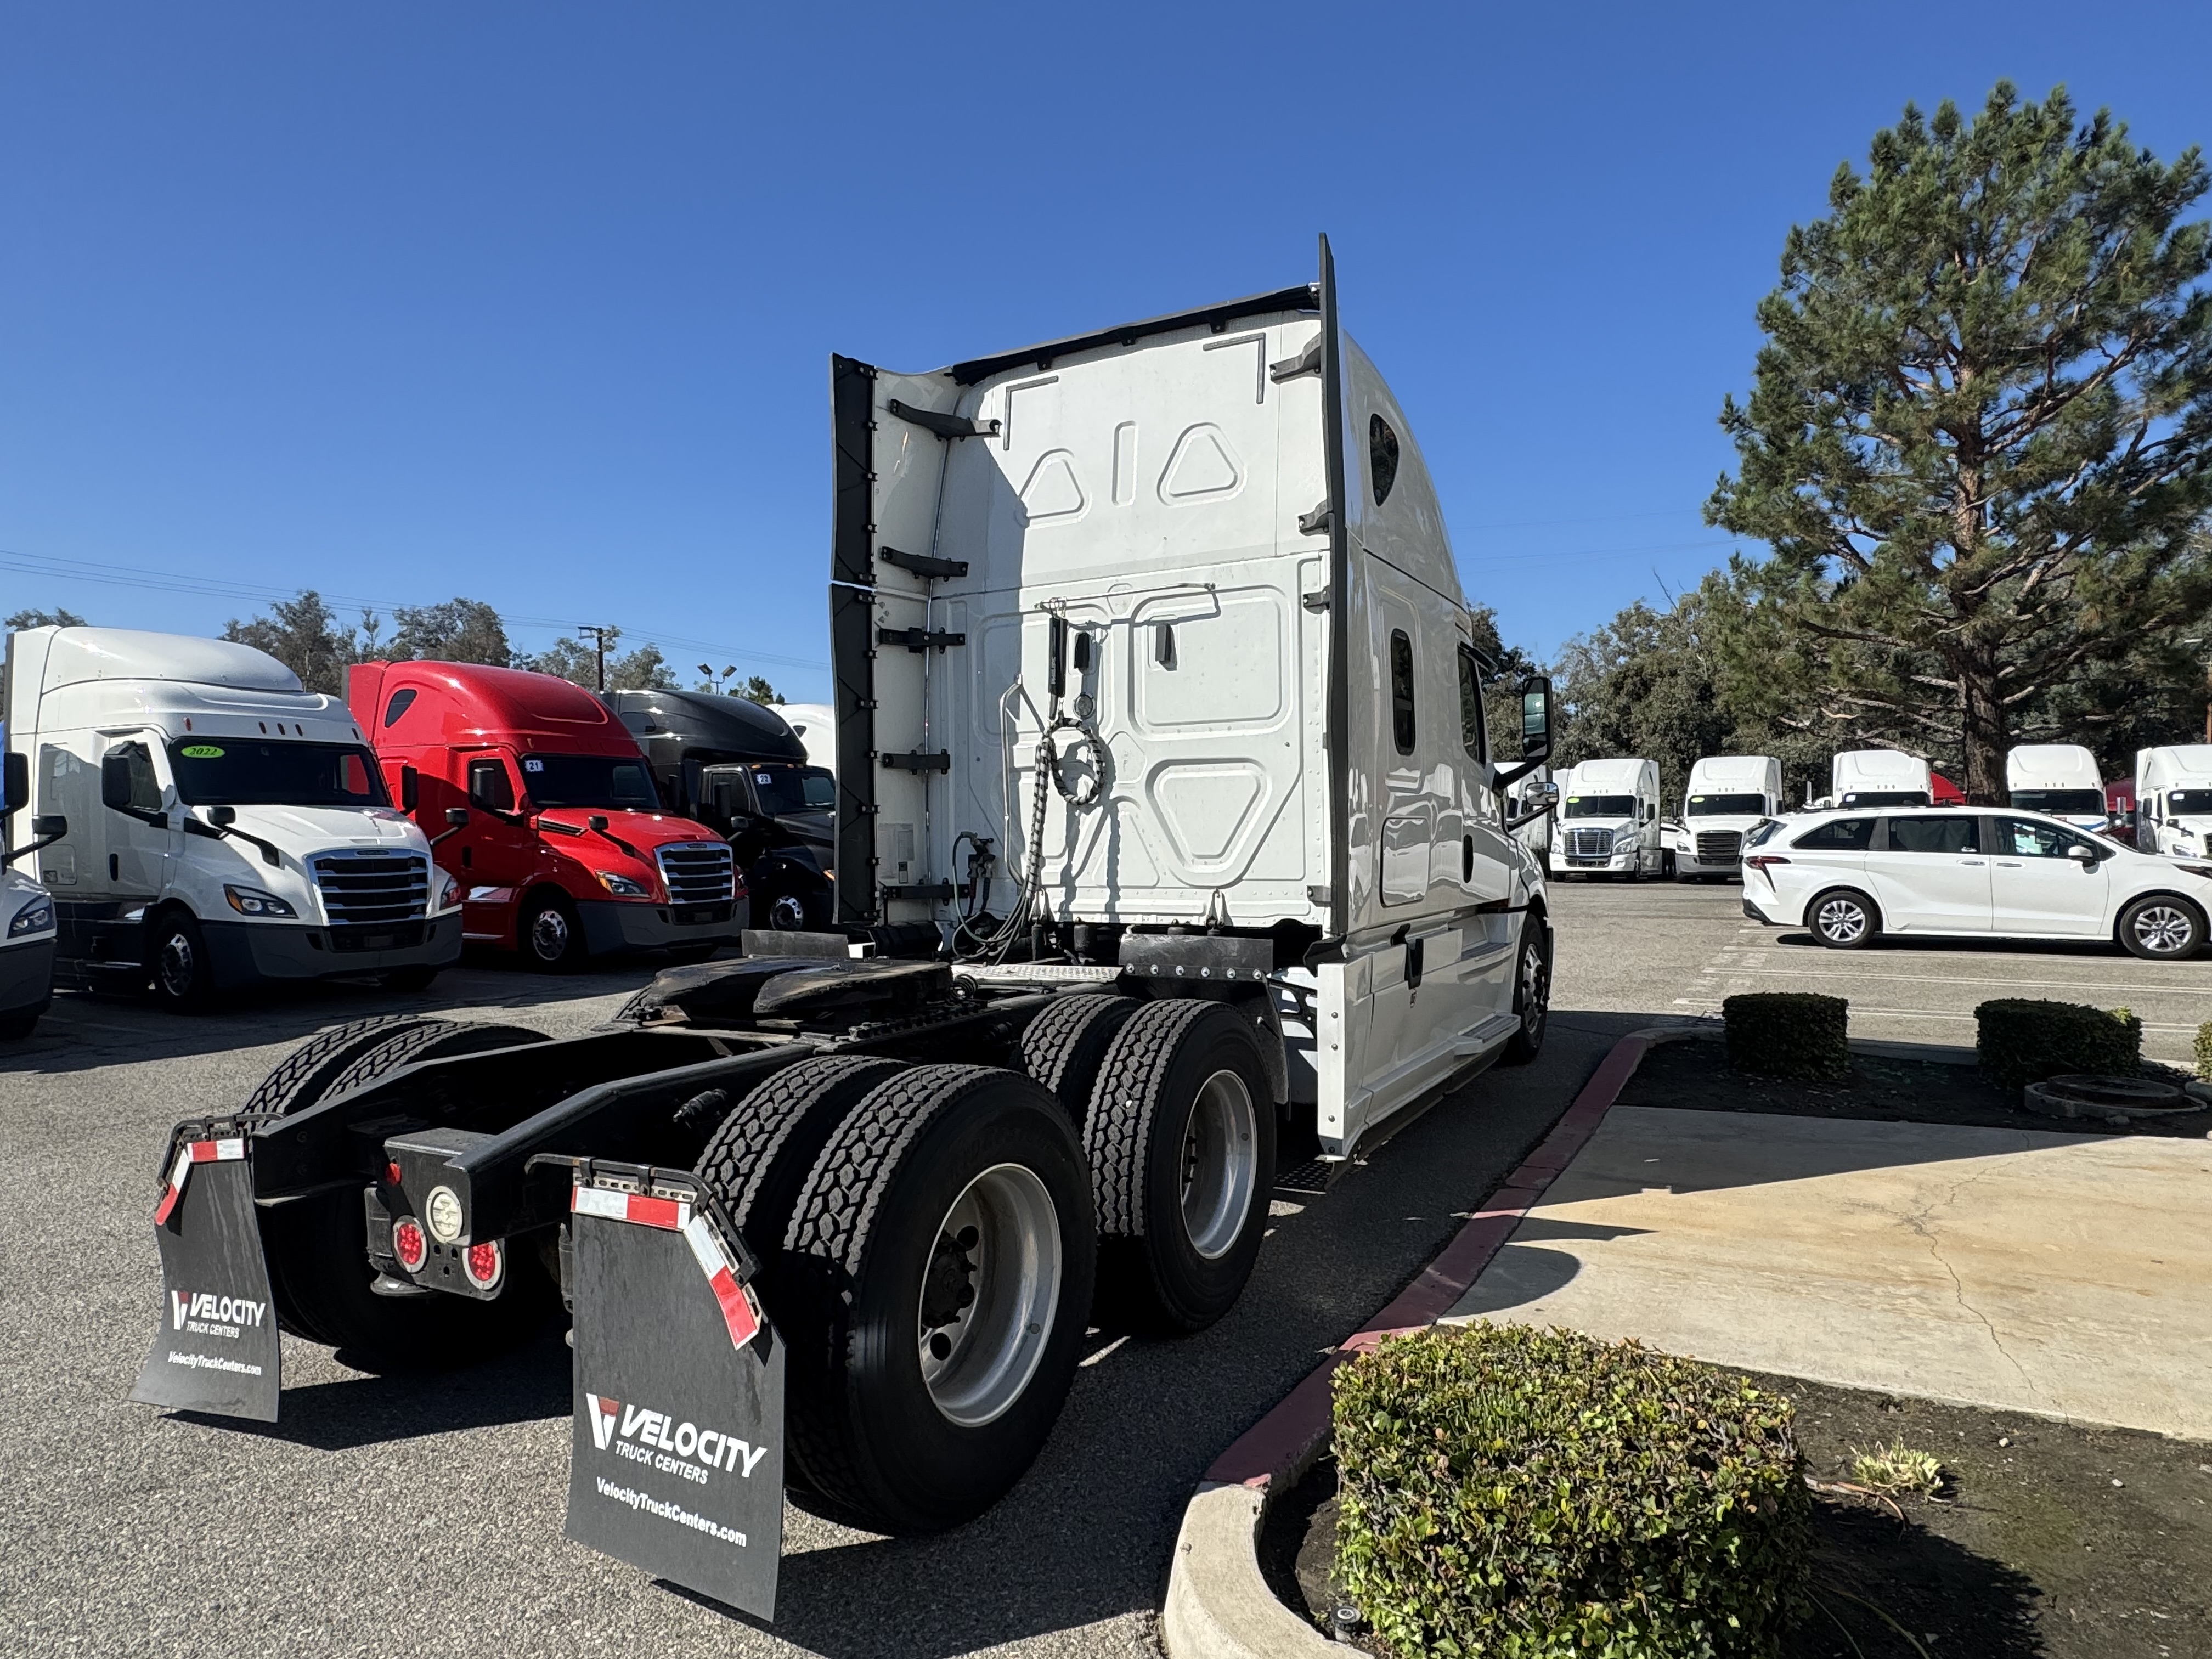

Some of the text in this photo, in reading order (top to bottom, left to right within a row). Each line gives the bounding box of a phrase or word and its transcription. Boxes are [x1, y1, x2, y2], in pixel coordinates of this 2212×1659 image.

[189, 747, 217, 755] 2022
[529, 761, 539, 770] 21
[190, 1293, 266, 1327] VELOCITY
[187, 1321, 240, 1339] TRUCK CENTERS
[168, 1351, 262, 1376] VelocityTruckCenters.com
[620, 1404, 768, 1478] VELOCITY
[616, 1441, 709, 1485] TRUCK CENTERS
[597, 1477, 747, 1547] VelocityTruckCenters.com
